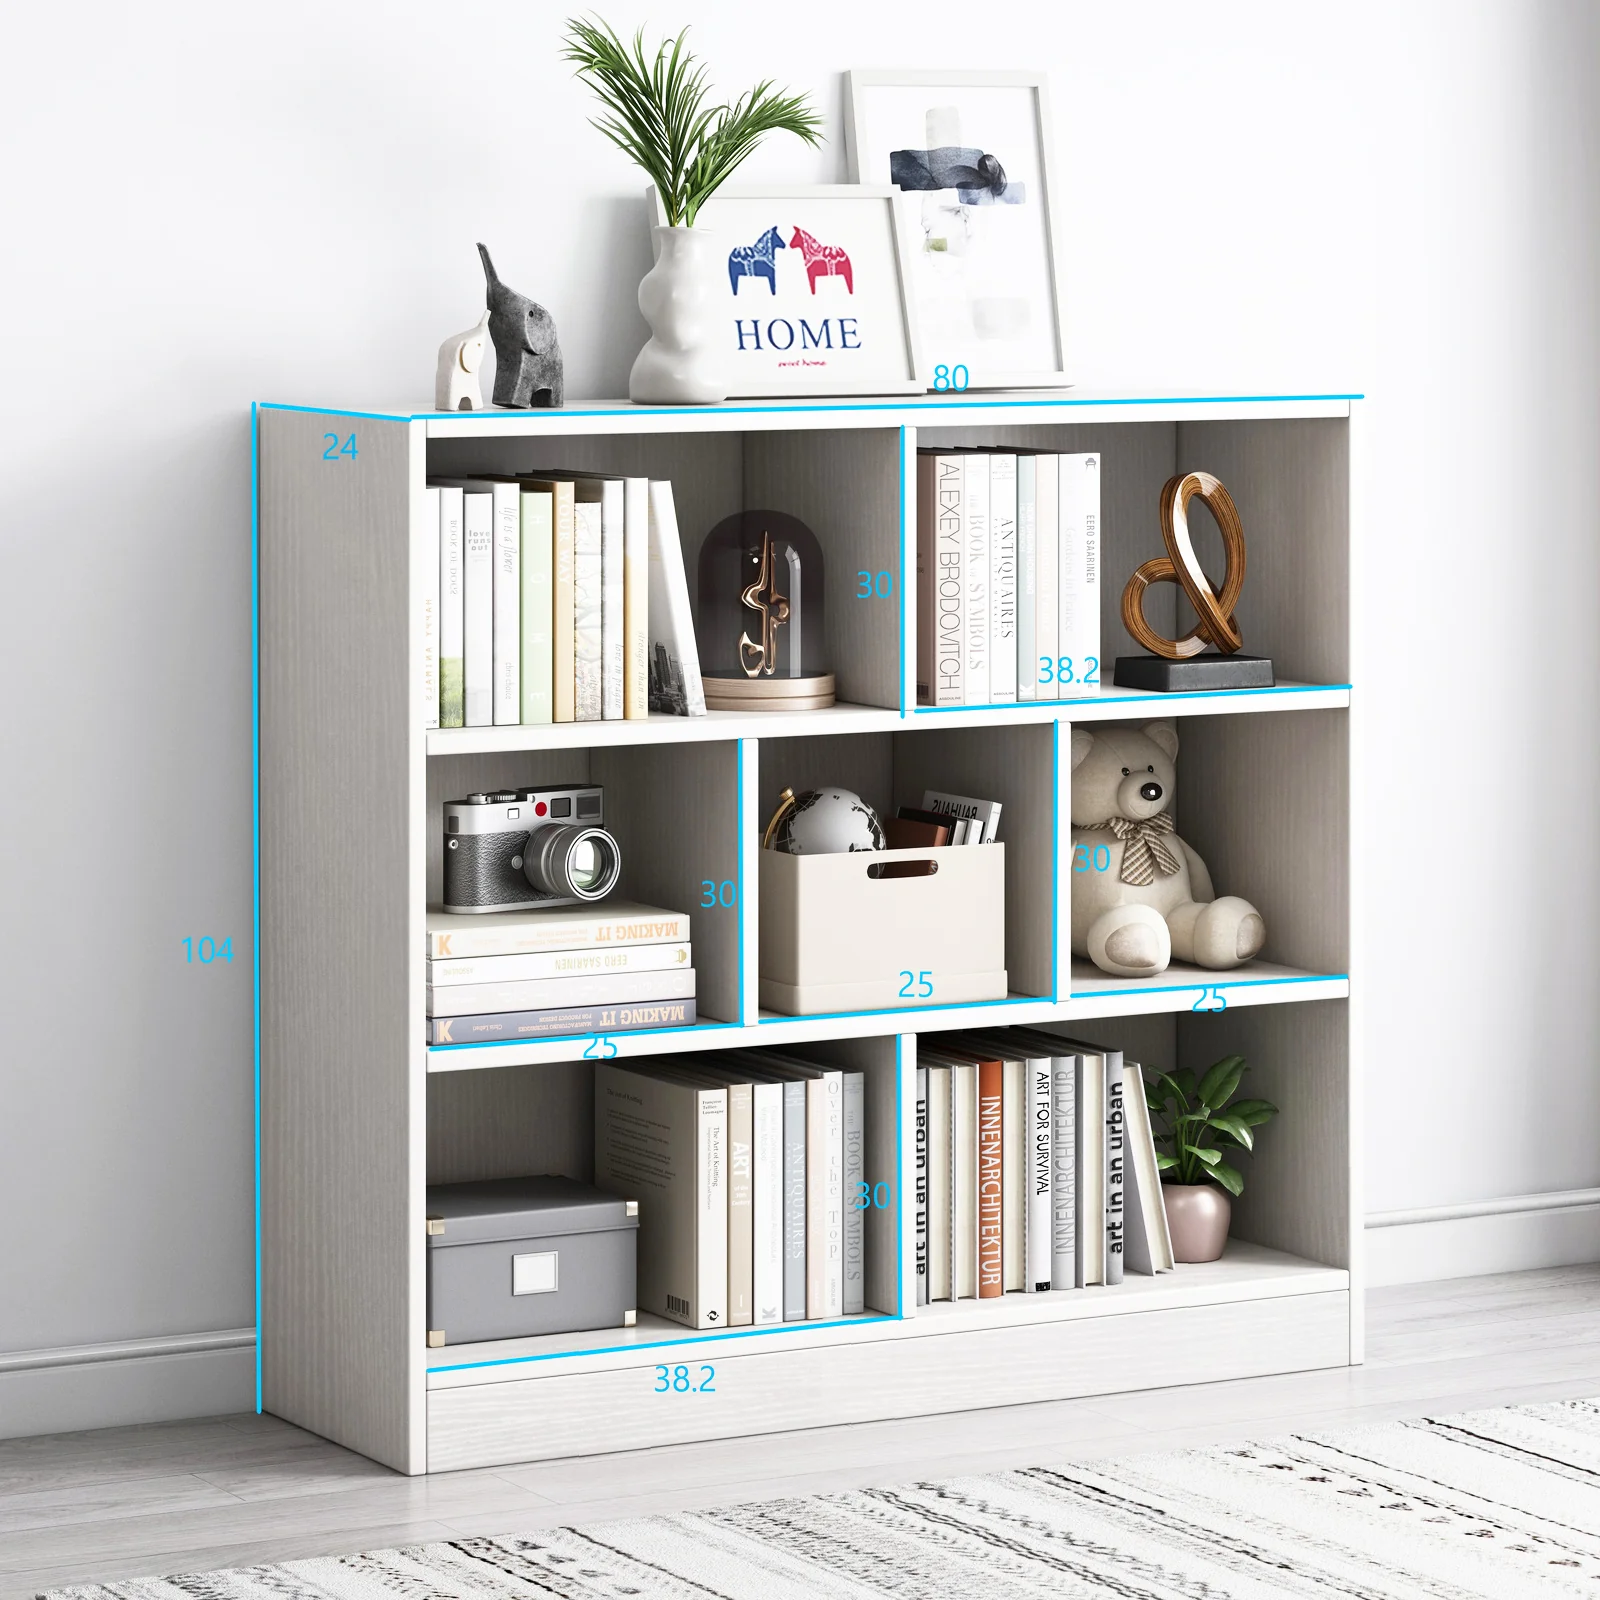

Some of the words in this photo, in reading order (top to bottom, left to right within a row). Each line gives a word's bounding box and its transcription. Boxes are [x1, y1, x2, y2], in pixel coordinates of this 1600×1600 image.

[734, 318, 863, 351] HOME
[499, 507, 518, 522] life
[558, 491, 572, 543] YOUR
[939, 461, 960, 545] ALEXEY
[468, 530, 491, 538] love
[503, 525, 515, 533] is
[969, 514, 985, 564] BOOK
[1086, 514, 1096, 537] EERO
[471, 544, 489, 552] out
[499, 544, 517, 574] flower
[1086, 540, 1096, 585] SAARINEN
[558, 548, 572, 585] WAY
[998, 517, 1014, 639] ANTIQUAIRES
[939, 551, 961, 690] BRODOVITCH
[969, 583, 986, 671] SYMBOLS
[614, 643, 624, 663] love
[635, 631, 645, 669] stronger
[611, 677, 623, 709] prague
[636, 671, 646, 693] than
[636, 695, 646, 710] sin
[595, 926, 615, 942] IT
[615, 921, 679, 941] MAKING
[555, 956, 601, 971] SAARINEN
[605, 954, 628, 967] EERO
[599, 1010, 616, 1026] IT
[620, 1005, 685, 1025] MAKING
[1036, 1072, 1050, 1097] ART
[1036, 1102, 1050, 1129] FOR
[1106, 1081, 1123, 1151] urban
[732, 1141, 749, 1179] ART
[847, 1130, 860, 1177] BOOK
[1036, 1134, 1050, 1196] SURVIVAL
[1054, 1069, 1075, 1255] INNENARCHITEKTUR
[711, 1160, 720, 1187] Knitting
[1110, 1156, 1123, 1184] an
[792, 1142, 804, 1260] ANTIQUAIRES
[981, 1095, 1001, 1286] INNENARCHITEKTUR
[1106, 1191, 1123, 1214] in
[847, 1196, 860, 1281] SYMBOLS
[1108, 1220, 1123, 1254] art
